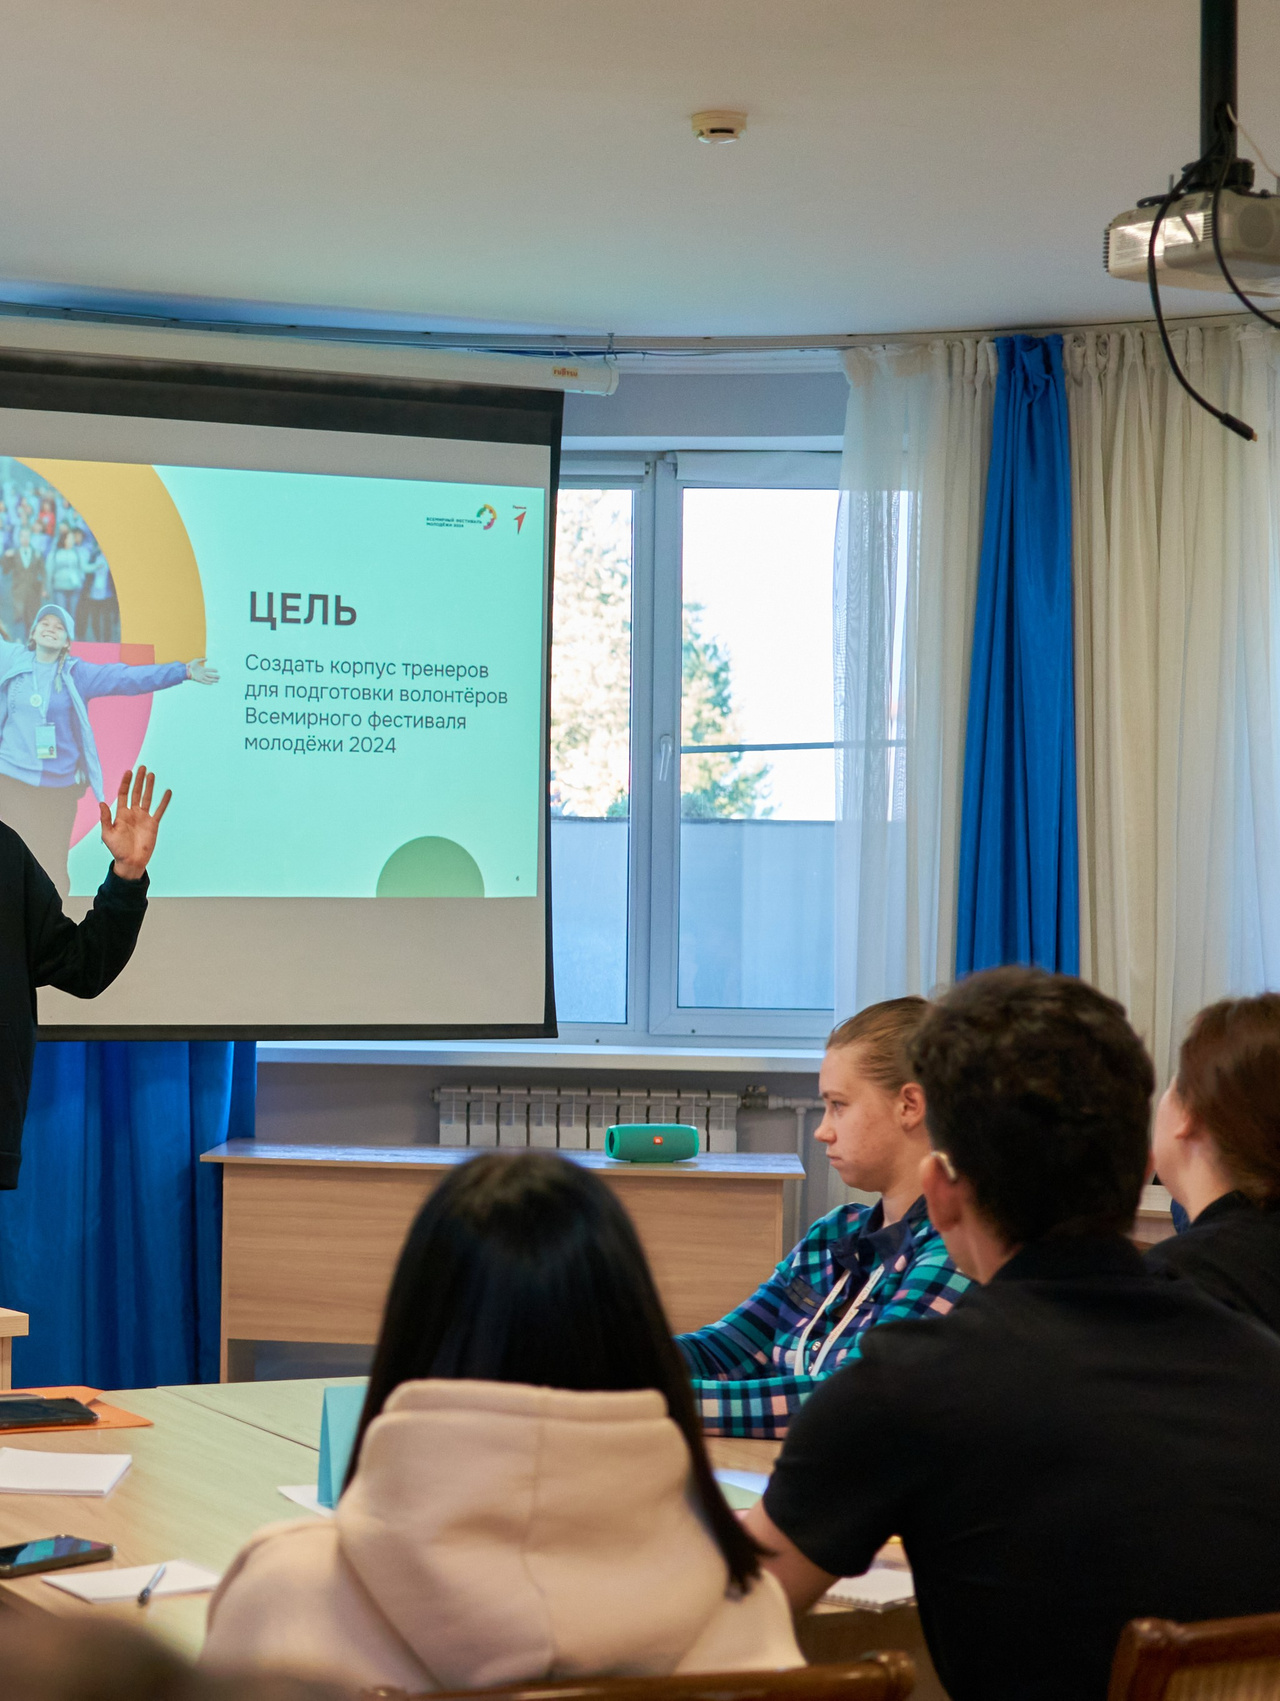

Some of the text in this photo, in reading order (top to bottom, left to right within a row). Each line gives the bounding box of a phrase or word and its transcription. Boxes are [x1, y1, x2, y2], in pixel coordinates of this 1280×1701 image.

[250, 591, 357, 631] ЦЕЛЬ
[245, 654, 489, 681] Создать корпус тренеров
[245, 683, 508, 707] для подготовки волонтёров
[245, 707, 467, 731] Всемирного фестиваля
[245, 735, 397, 755] молодёжи 2024
